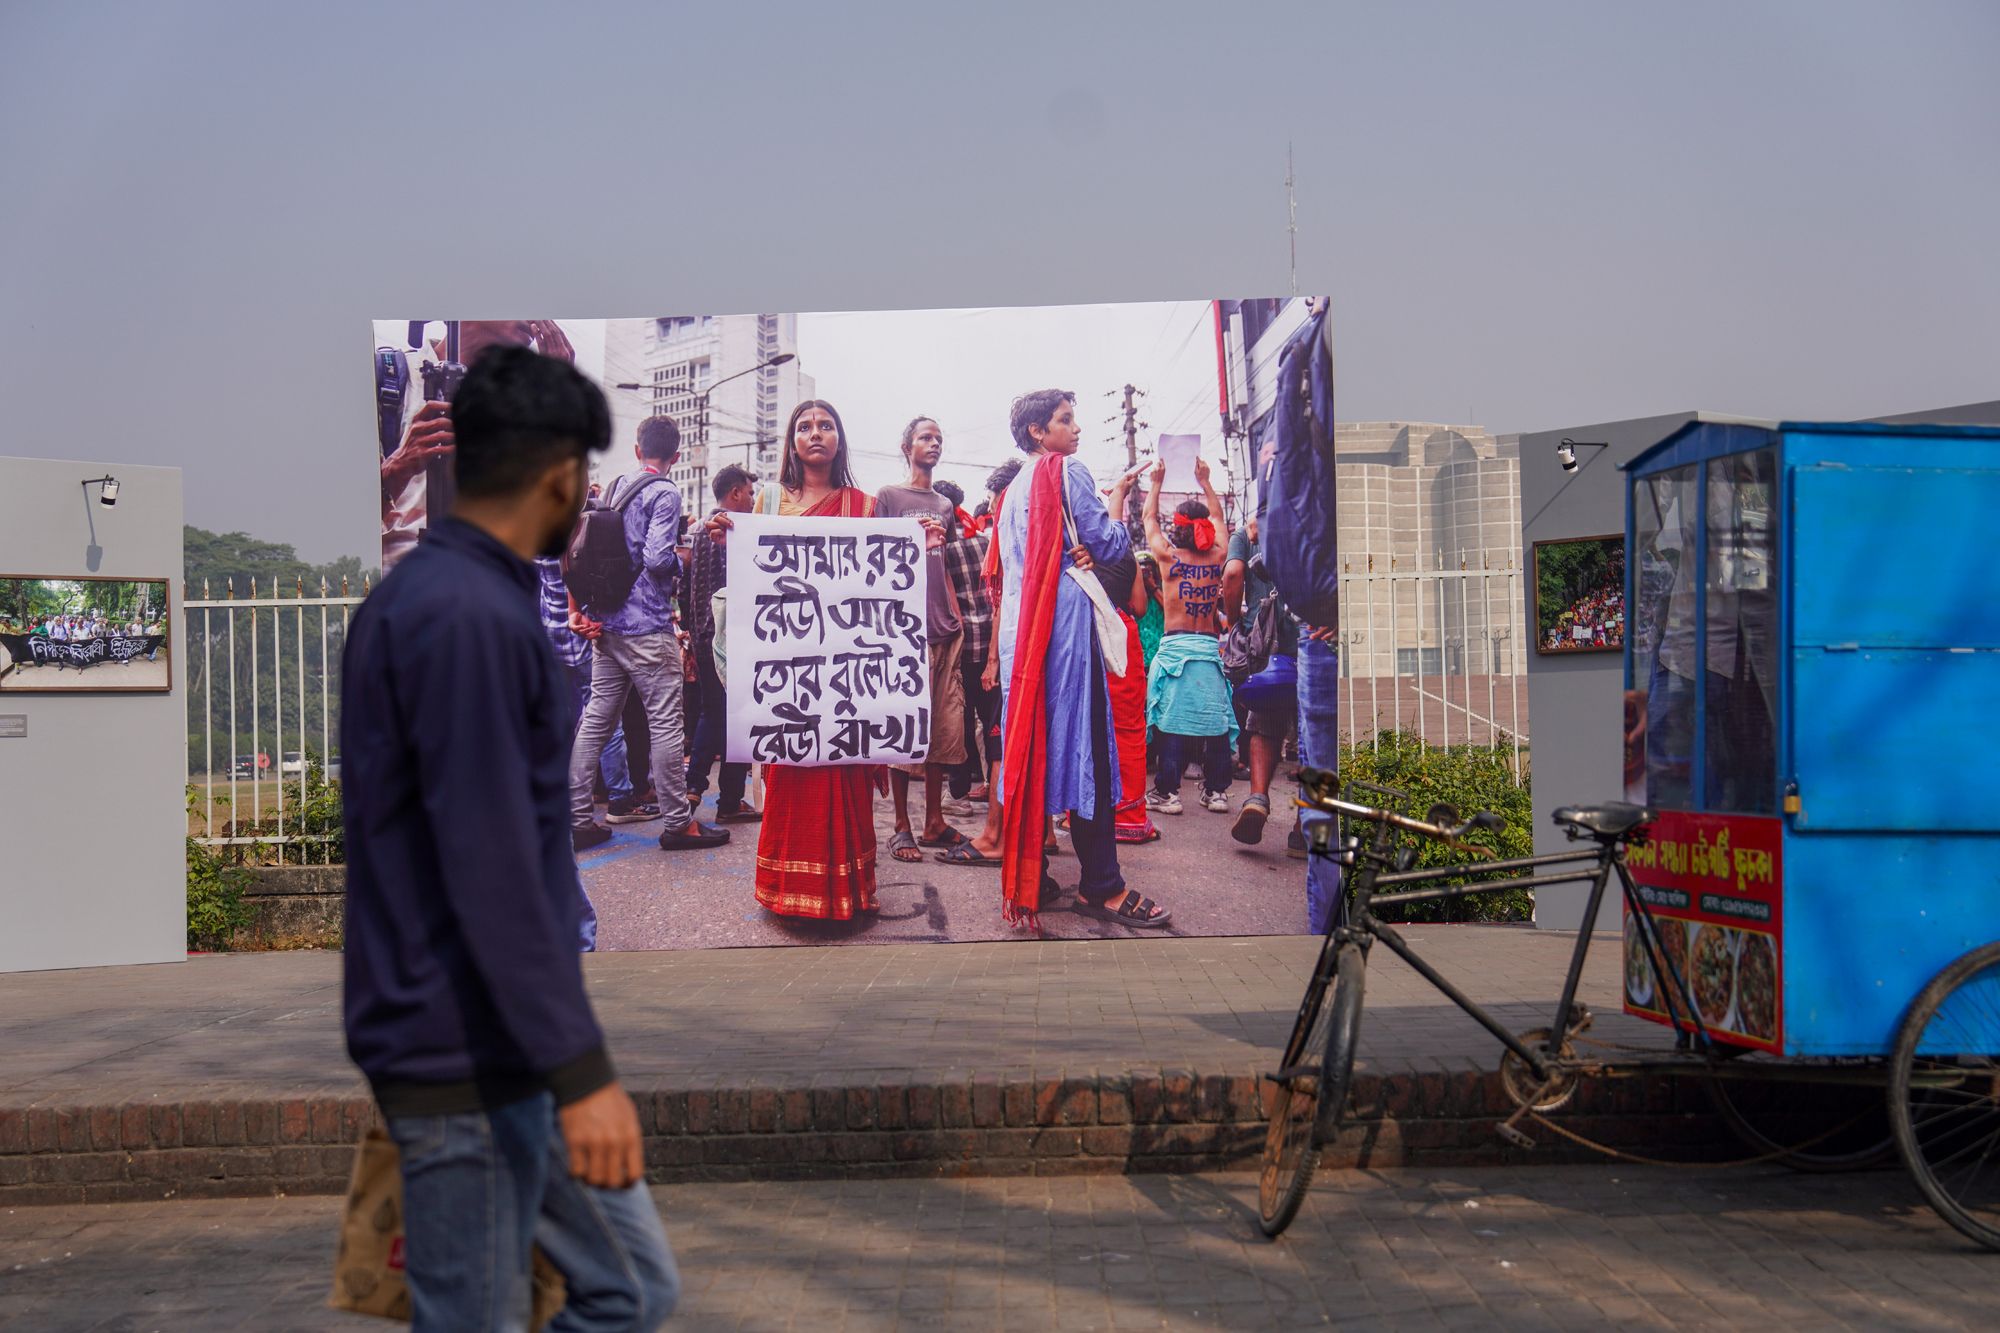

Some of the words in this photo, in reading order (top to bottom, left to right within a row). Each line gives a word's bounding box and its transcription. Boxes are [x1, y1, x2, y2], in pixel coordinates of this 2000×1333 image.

[753, 534, 860, 580] আমার
[865, 534, 920, 591] রক্ত
[1169, 555, 1221, 580] স্বৈরাচার
[753, 575, 826, 646] রেডী
[1179, 581, 1219, 600] নিপাত
[1184, 601, 1214, 618] যাক
[753, 655, 826, 711] তোর
[829, 635, 925, 717] বুলেটও
[749, 702, 822, 763] রেডী
[828, 707, 929, 761] রাখ!
[1734, 847, 1774, 891] ফুচকা
